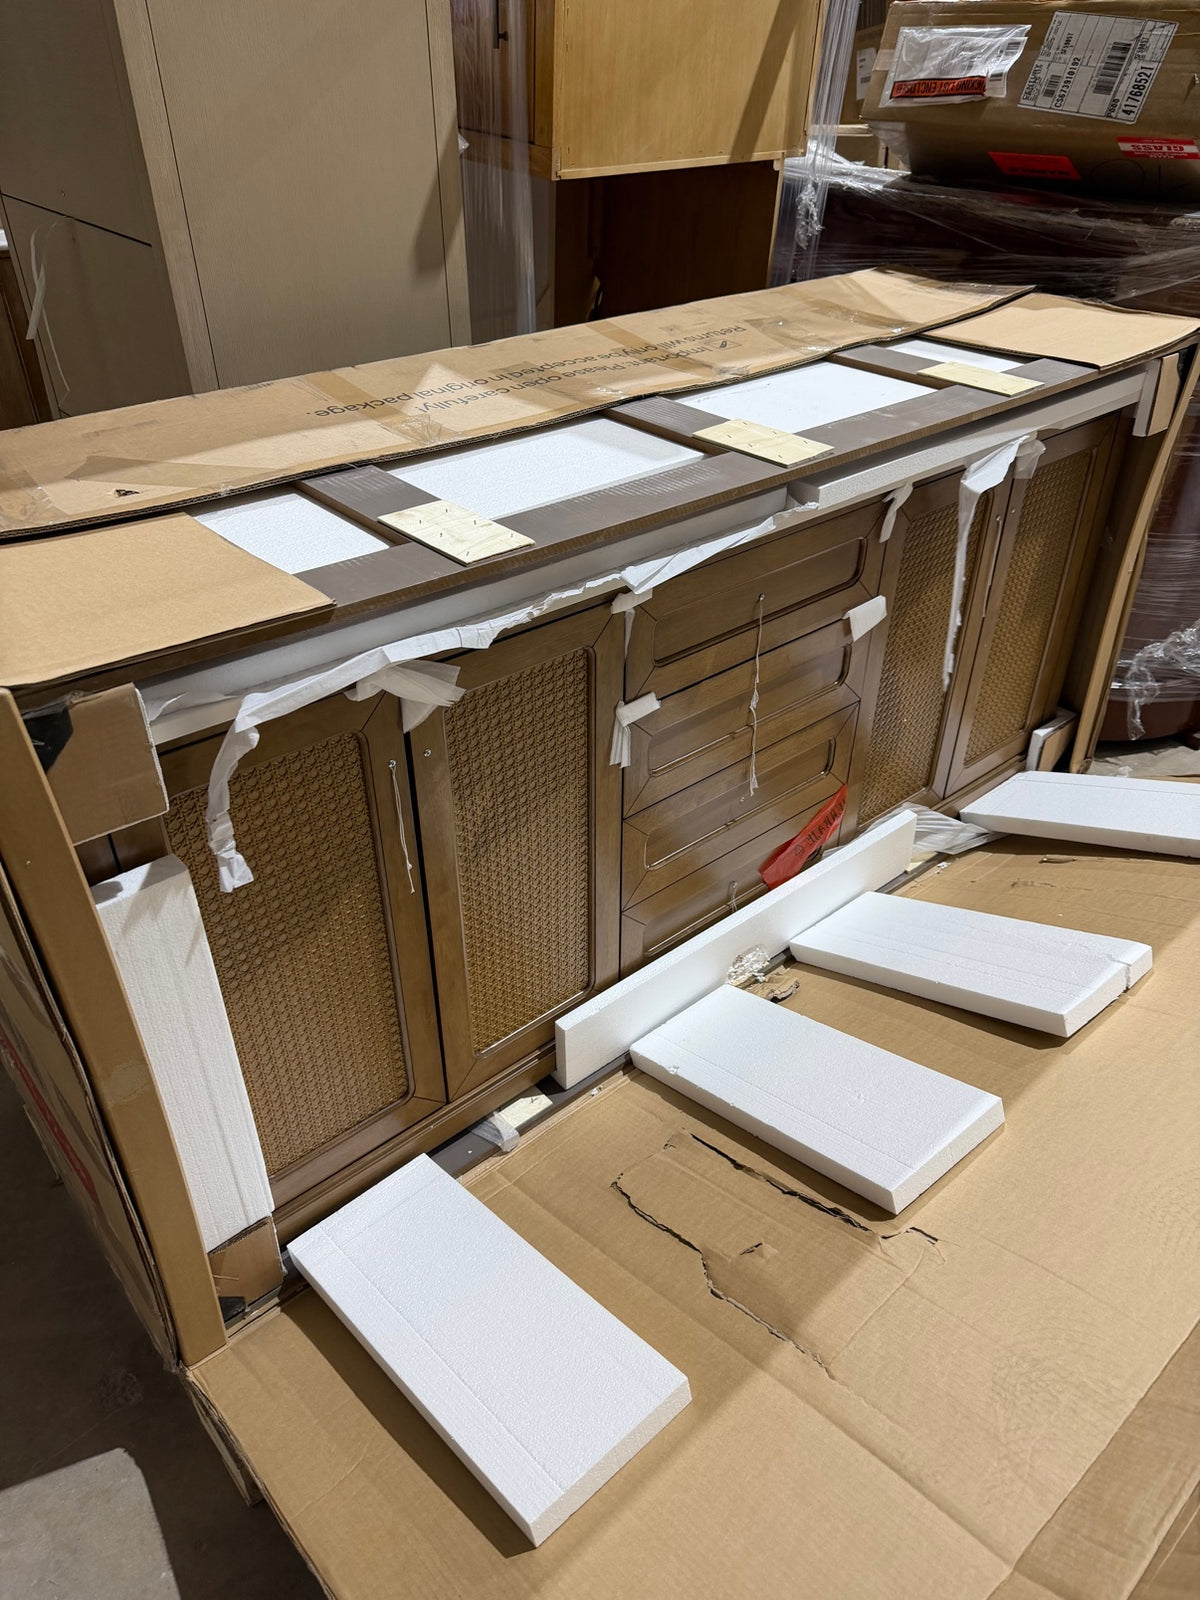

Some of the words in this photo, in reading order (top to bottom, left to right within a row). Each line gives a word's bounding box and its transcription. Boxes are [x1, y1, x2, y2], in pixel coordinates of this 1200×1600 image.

[896, 81, 938, 95] ENCLOSED
[939, 81, 955, 92] LIST
[1054, 57, 1082, 108] CS673910192
[1122, 66, 1155, 116] 41768521
[1131, 144, 1184, 152] GLASS
[657, 337, 682, 351] will
[681, 325, 747, 346] Returns
[596, 351, 624, 364] be
[623, 345, 658, 359] only
[625, 345, 709, 369] Important:
[490, 373, 510, 384] in
[509, 355, 596, 384] accepted
[563, 363, 625, 379] Please
[413, 378, 489, 400] original
[511, 372, 563, 393] open
[306, 391, 414, 420] package.
[414, 387, 511, 413] carefully!
